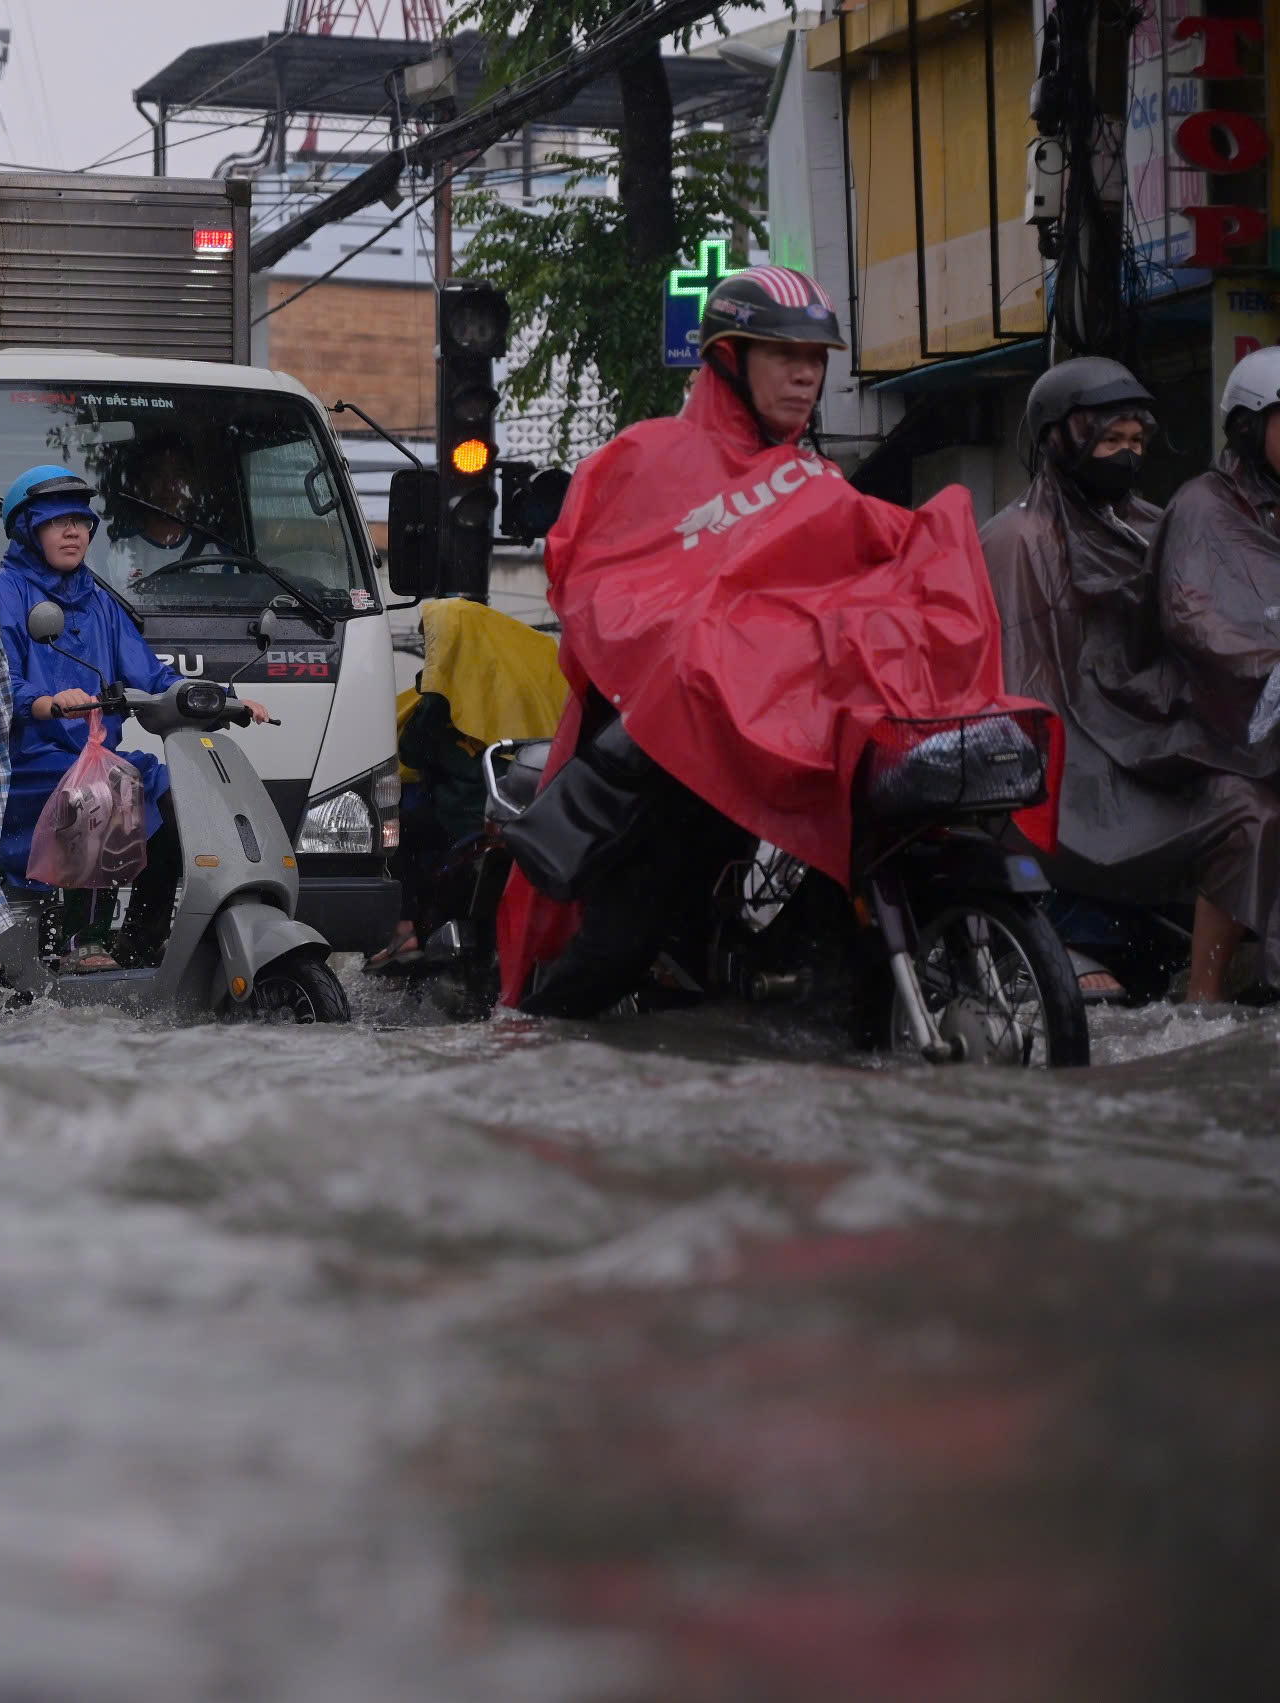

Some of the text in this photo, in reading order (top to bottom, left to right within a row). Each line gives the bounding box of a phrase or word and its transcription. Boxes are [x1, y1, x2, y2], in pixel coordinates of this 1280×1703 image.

[81, 394, 102, 405] TÂY
[106, 392, 128, 405] BẮC
[131, 396, 148, 406] SÀI
[152, 396, 174, 408] GÒN
[267, 664, 328, 676] 270
